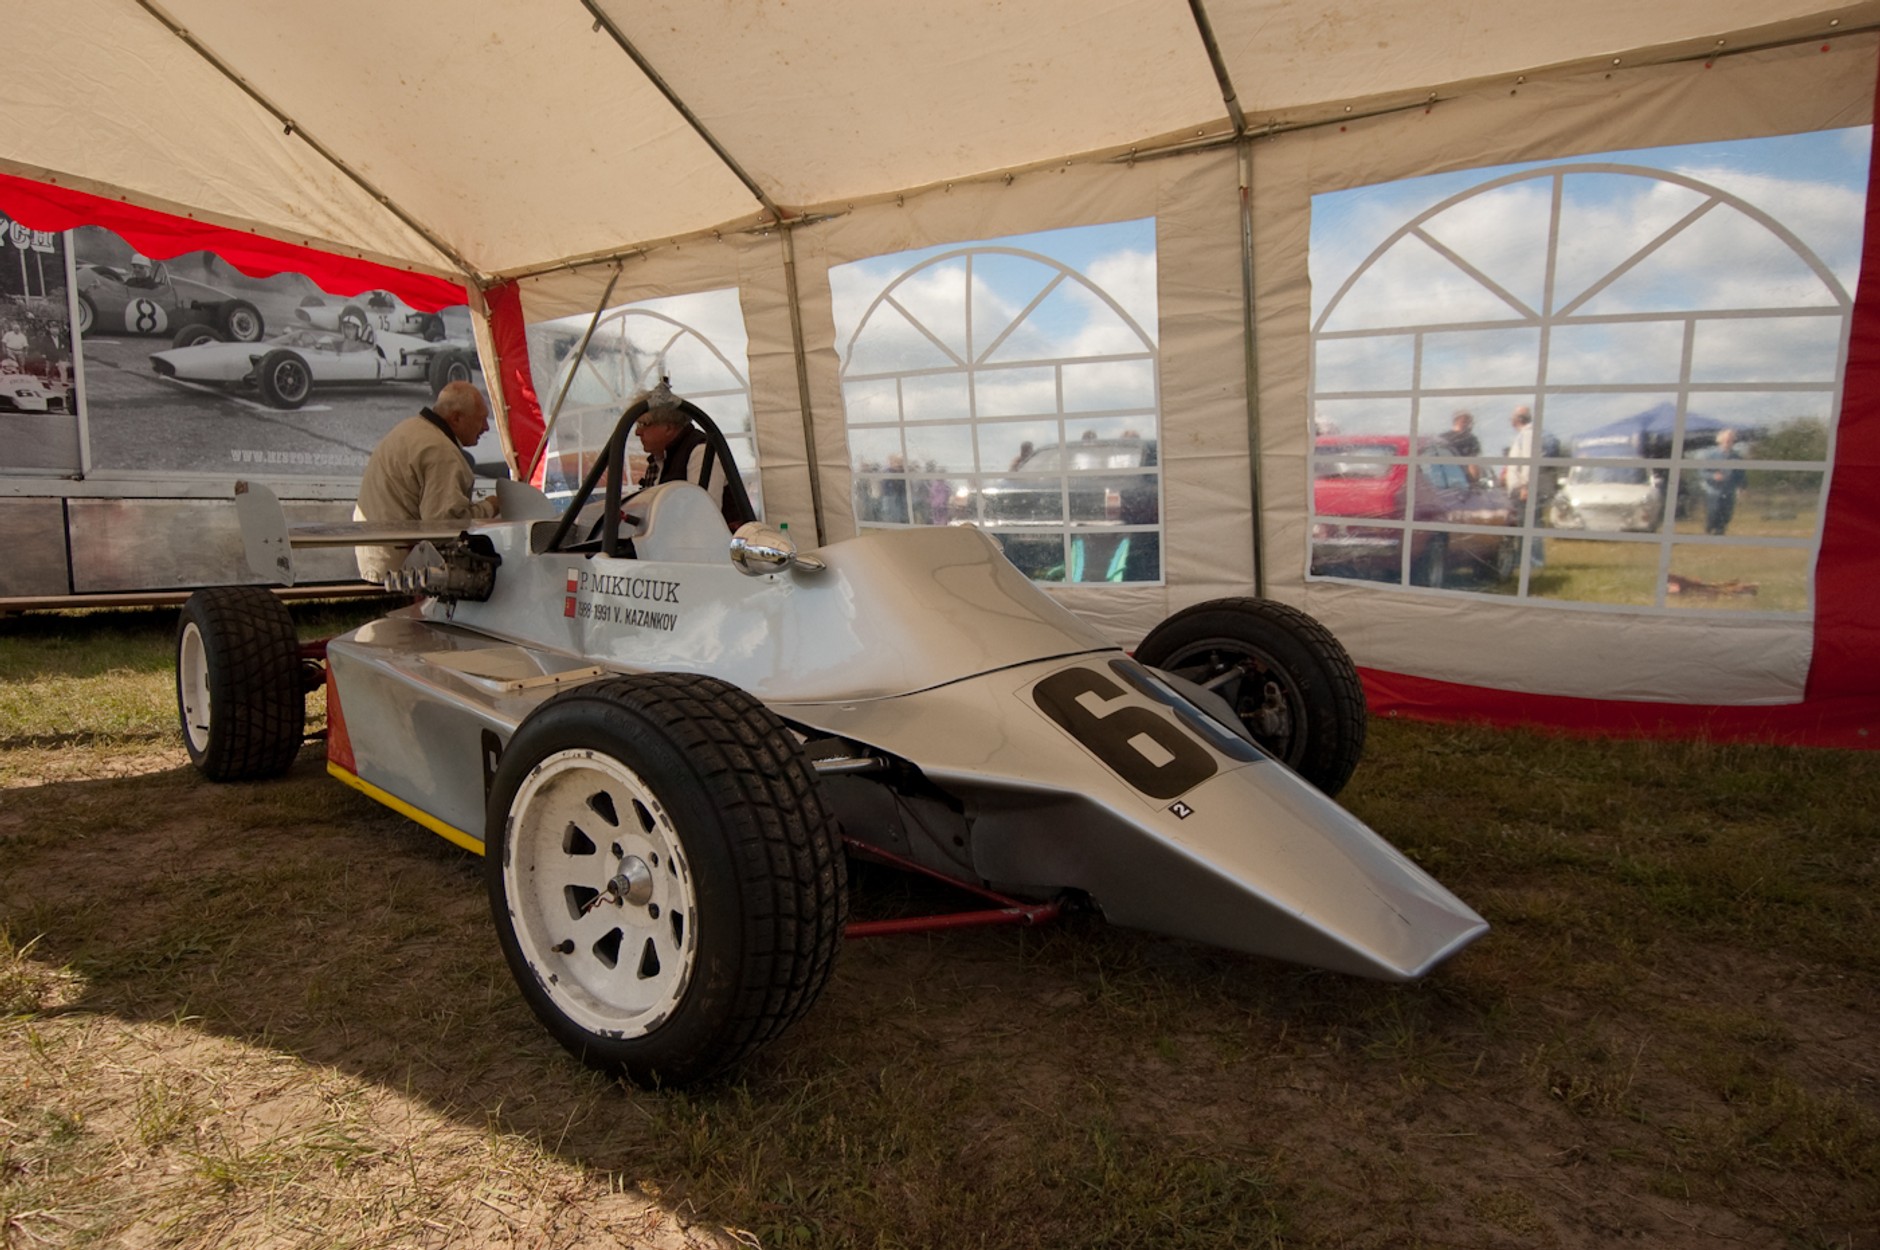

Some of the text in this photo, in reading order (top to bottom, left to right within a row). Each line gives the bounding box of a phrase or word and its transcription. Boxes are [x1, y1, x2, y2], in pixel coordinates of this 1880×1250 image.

[135, 298, 158, 333] 8
[580, 571, 681, 604] P. MIKICIUK
[624, 608, 678, 632] KAZANKOV
